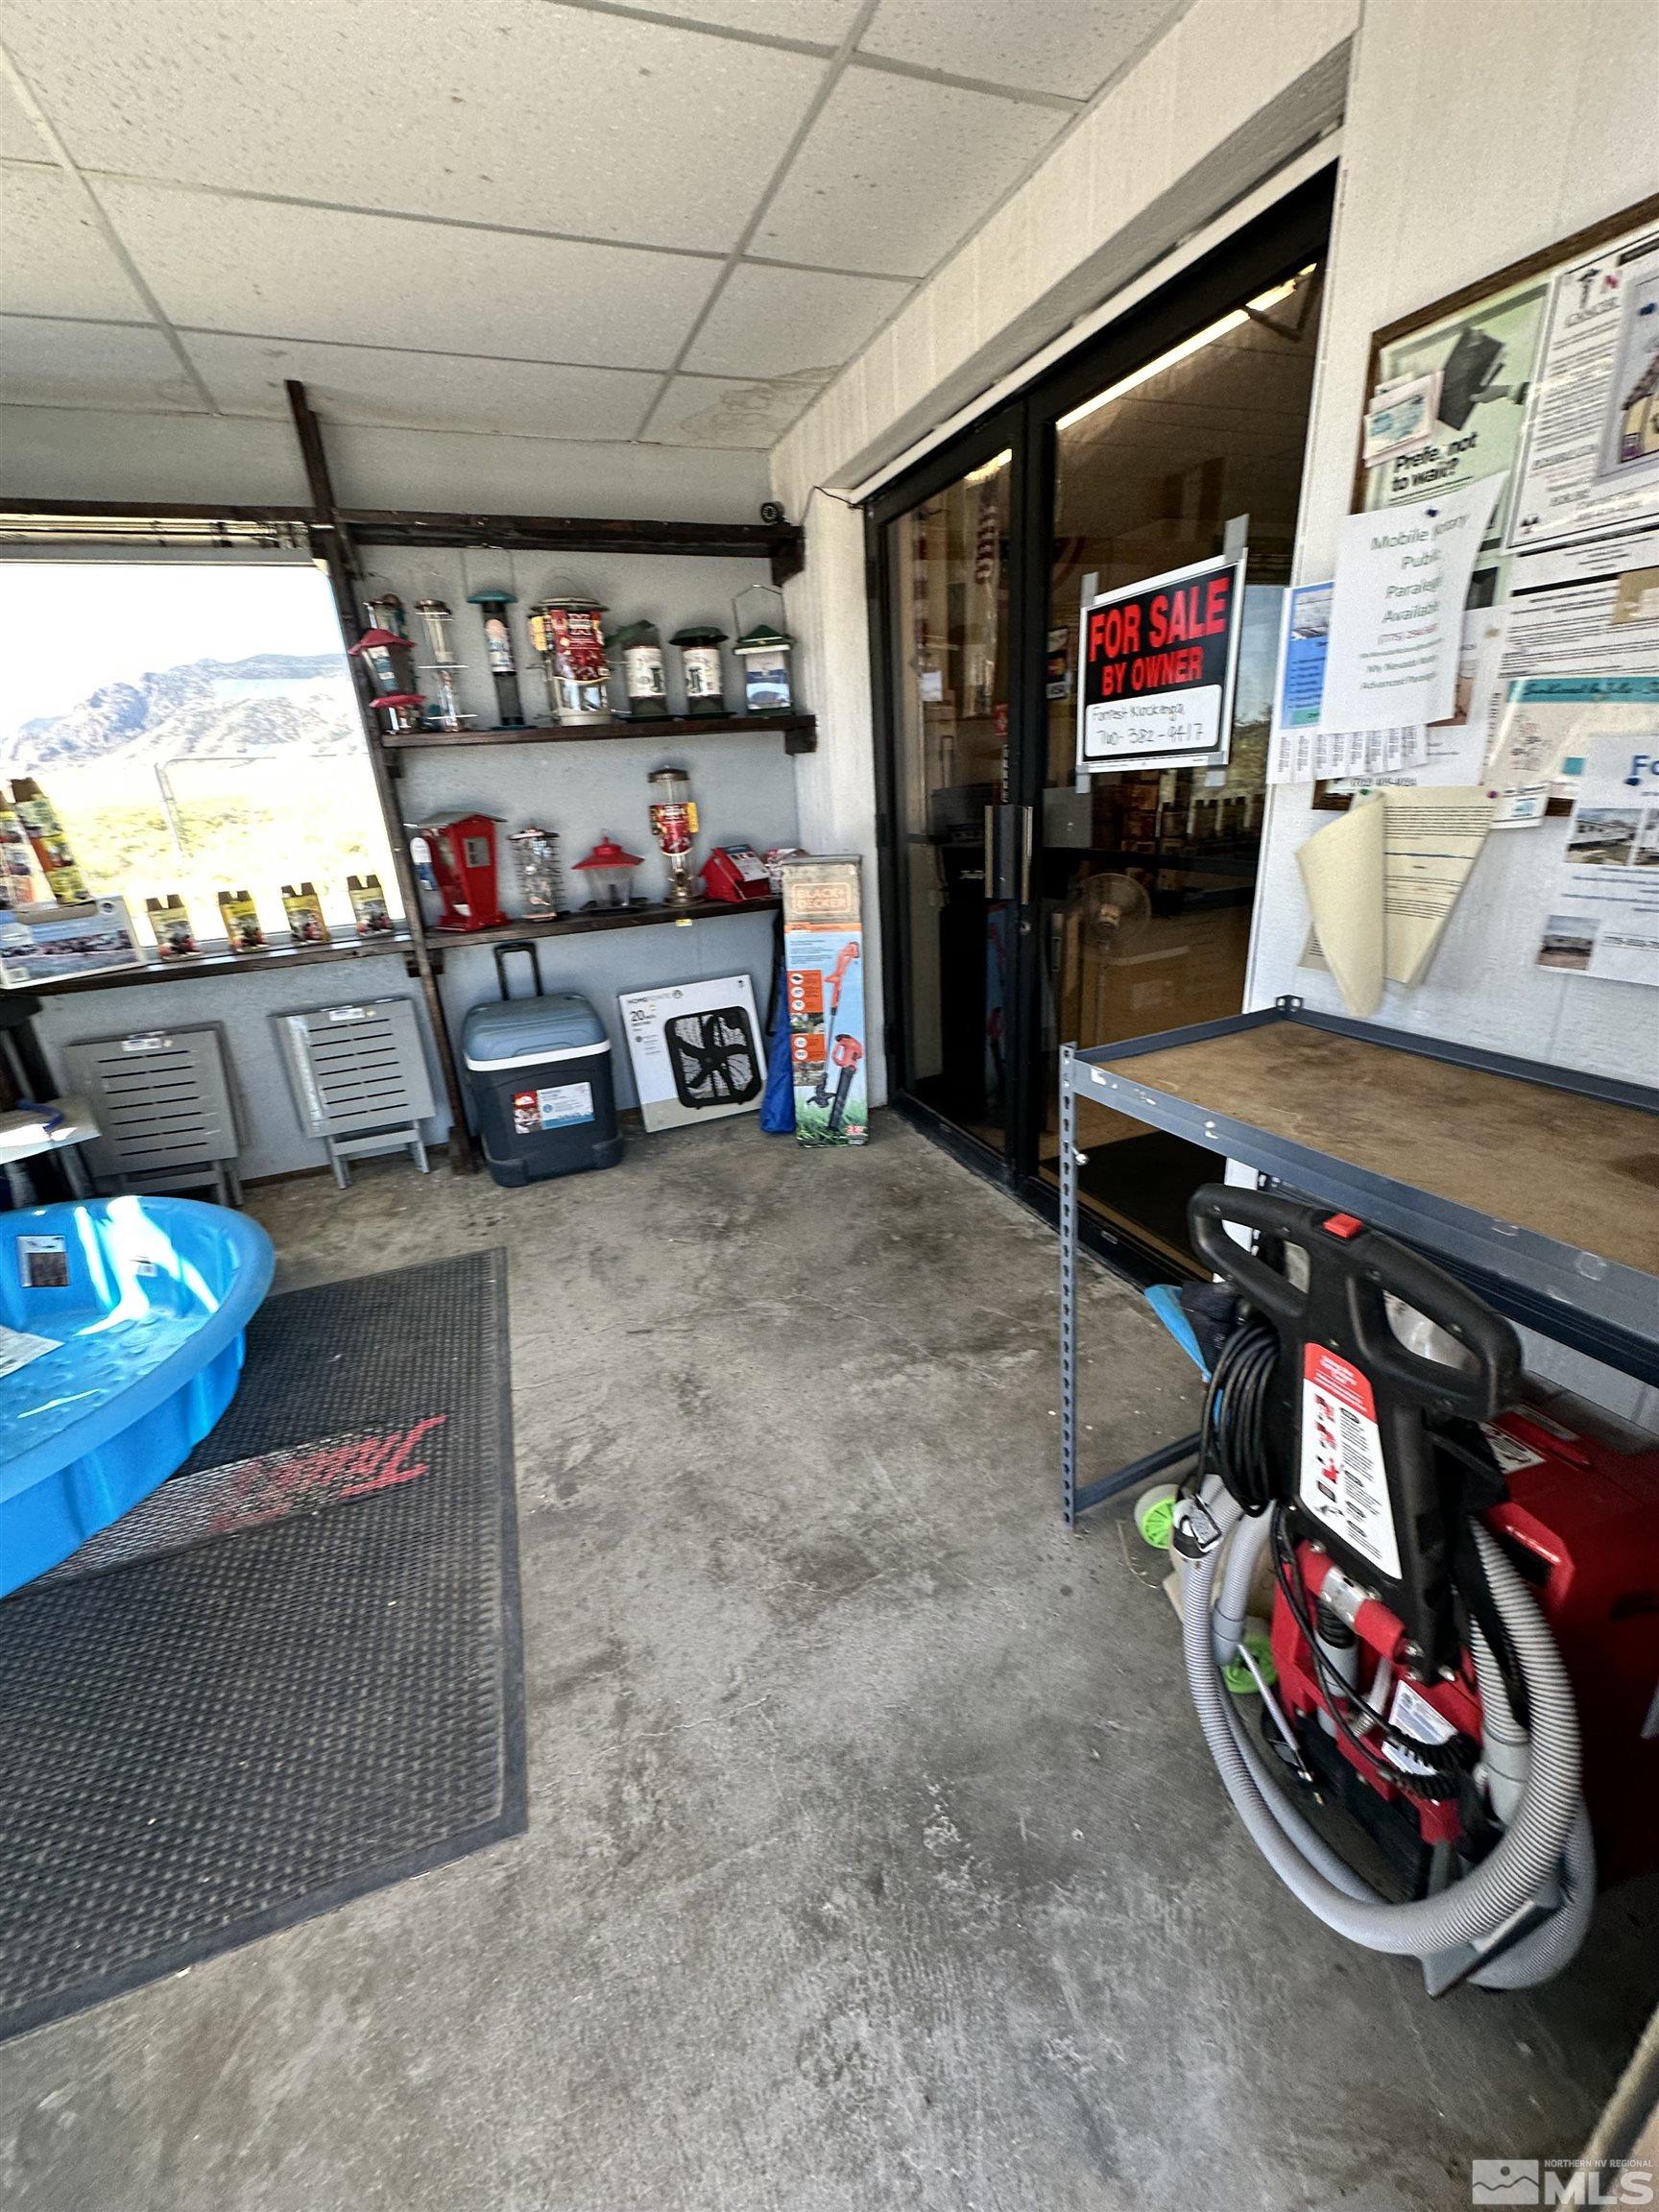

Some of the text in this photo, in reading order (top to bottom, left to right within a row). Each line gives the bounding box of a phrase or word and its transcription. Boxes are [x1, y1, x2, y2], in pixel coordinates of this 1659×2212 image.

[1447, 431, 1479, 456] not
[1391, 477, 1409, 492] to
[1370, 529, 1430, 550] Mobile
[1089, 577, 1230, 662] FOR SALE
[1101, 646, 1204, 696] BY OWNER
